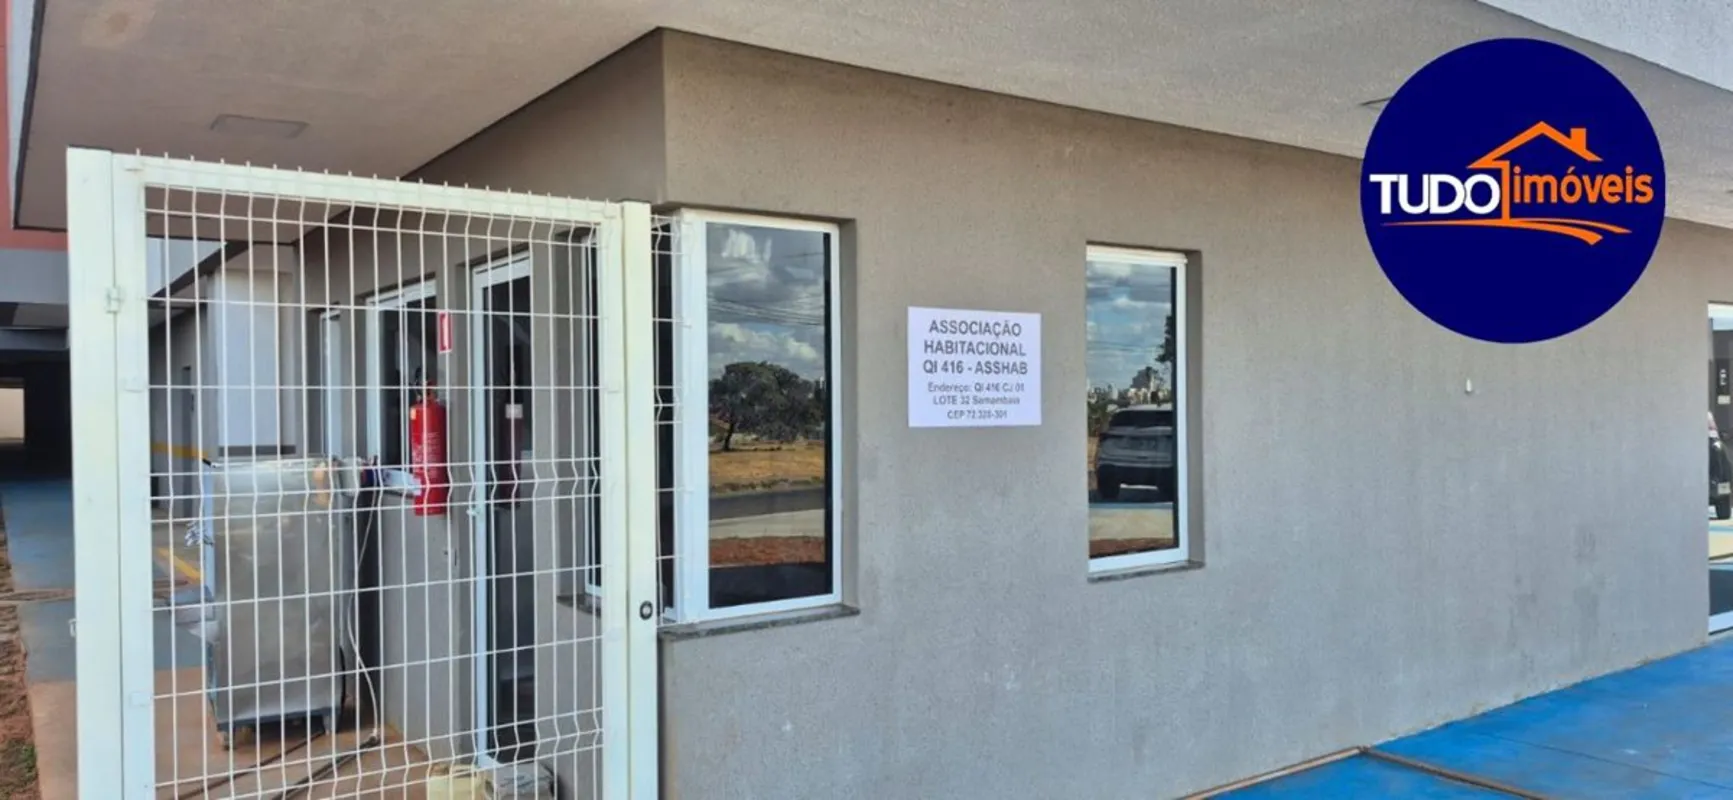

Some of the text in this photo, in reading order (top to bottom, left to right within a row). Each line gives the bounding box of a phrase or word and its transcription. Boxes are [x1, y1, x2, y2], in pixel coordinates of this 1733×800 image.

[929, 319, 1022, 338] ASSOCIAÇÃO
[923, 340, 1027, 356] HABITACIONAL
[923, 359, 938, 375] QI
[941, 360, 964, 375] 416
[974, 361, 1028, 375] ASSHAB
[927, 382, 971, 393] Endereço:
[974, 383, 984, 393] QI
[933, 395, 957, 405] LOTE
[947, 409, 964, 419] CEP
